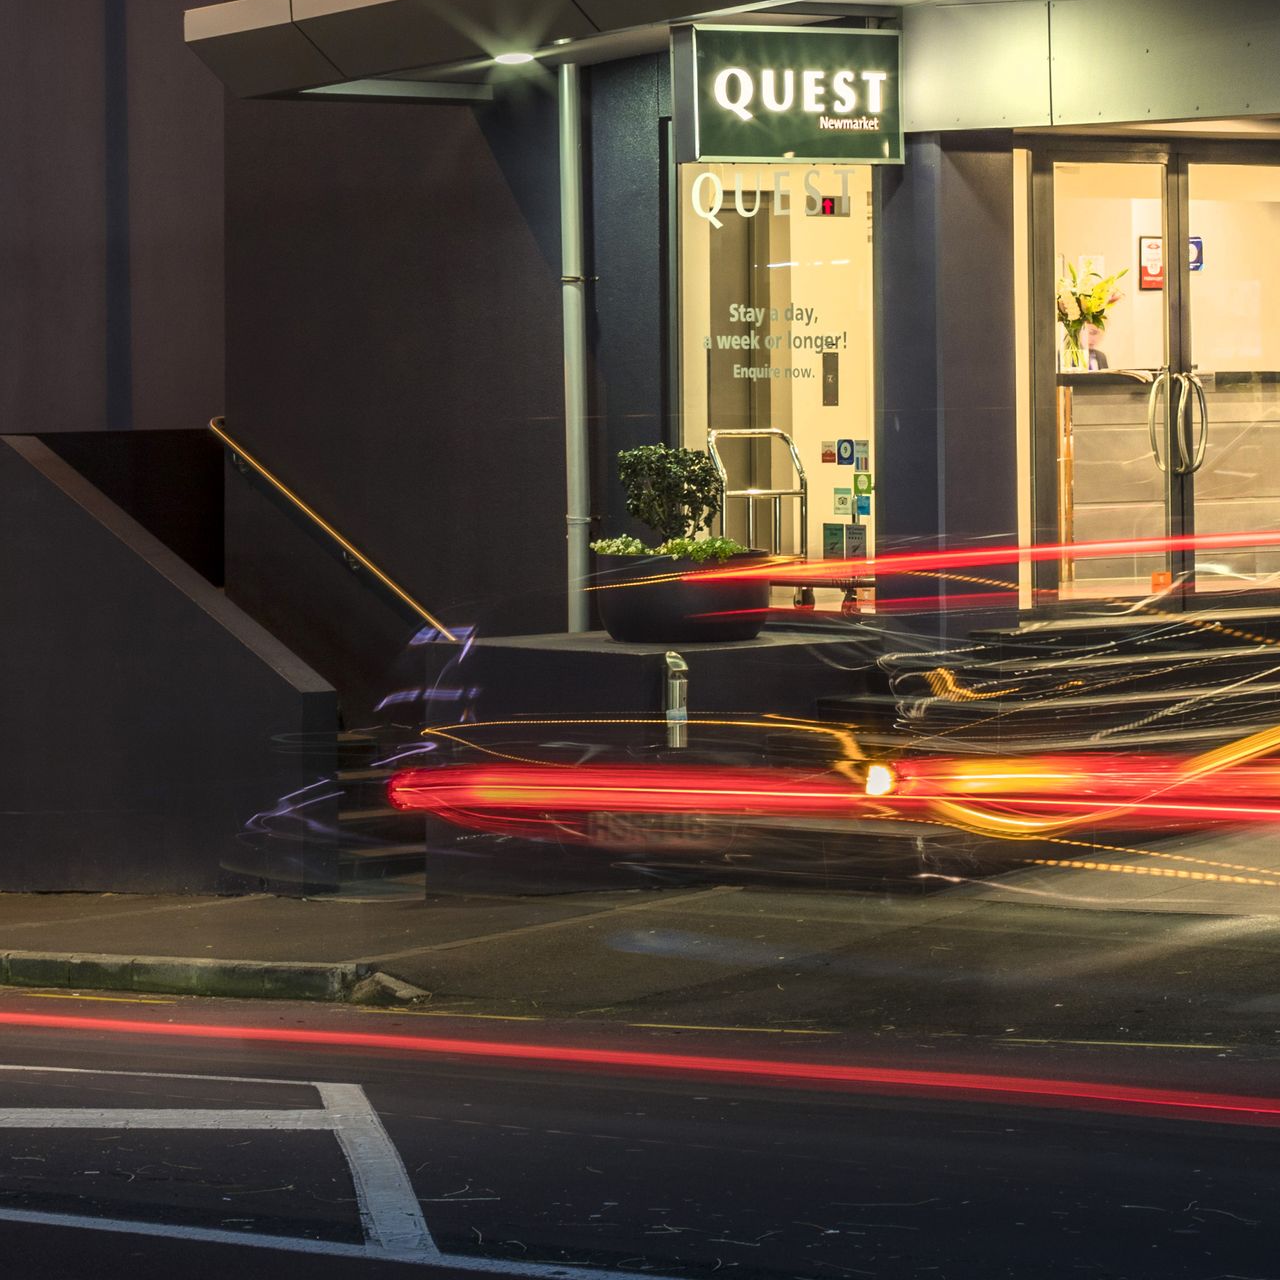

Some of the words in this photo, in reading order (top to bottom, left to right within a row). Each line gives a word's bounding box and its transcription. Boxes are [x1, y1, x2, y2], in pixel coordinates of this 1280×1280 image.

[713, 66, 888, 120] QUEST
[819, 114, 880, 132] Newmarket
[691, 168, 856, 230] QUEST
[729, 303, 766, 327] Stay
[769, 308, 780, 322] a
[784, 303, 819, 326] day,
[703, 336, 712, 349] a
[716, 330, 760, 350] week
[764, 336, 782, 350] or
[787, 330, 848, 355] longer!
[732, 363, 781, 382] Enquire
[784, 365, 816, 379] now.
